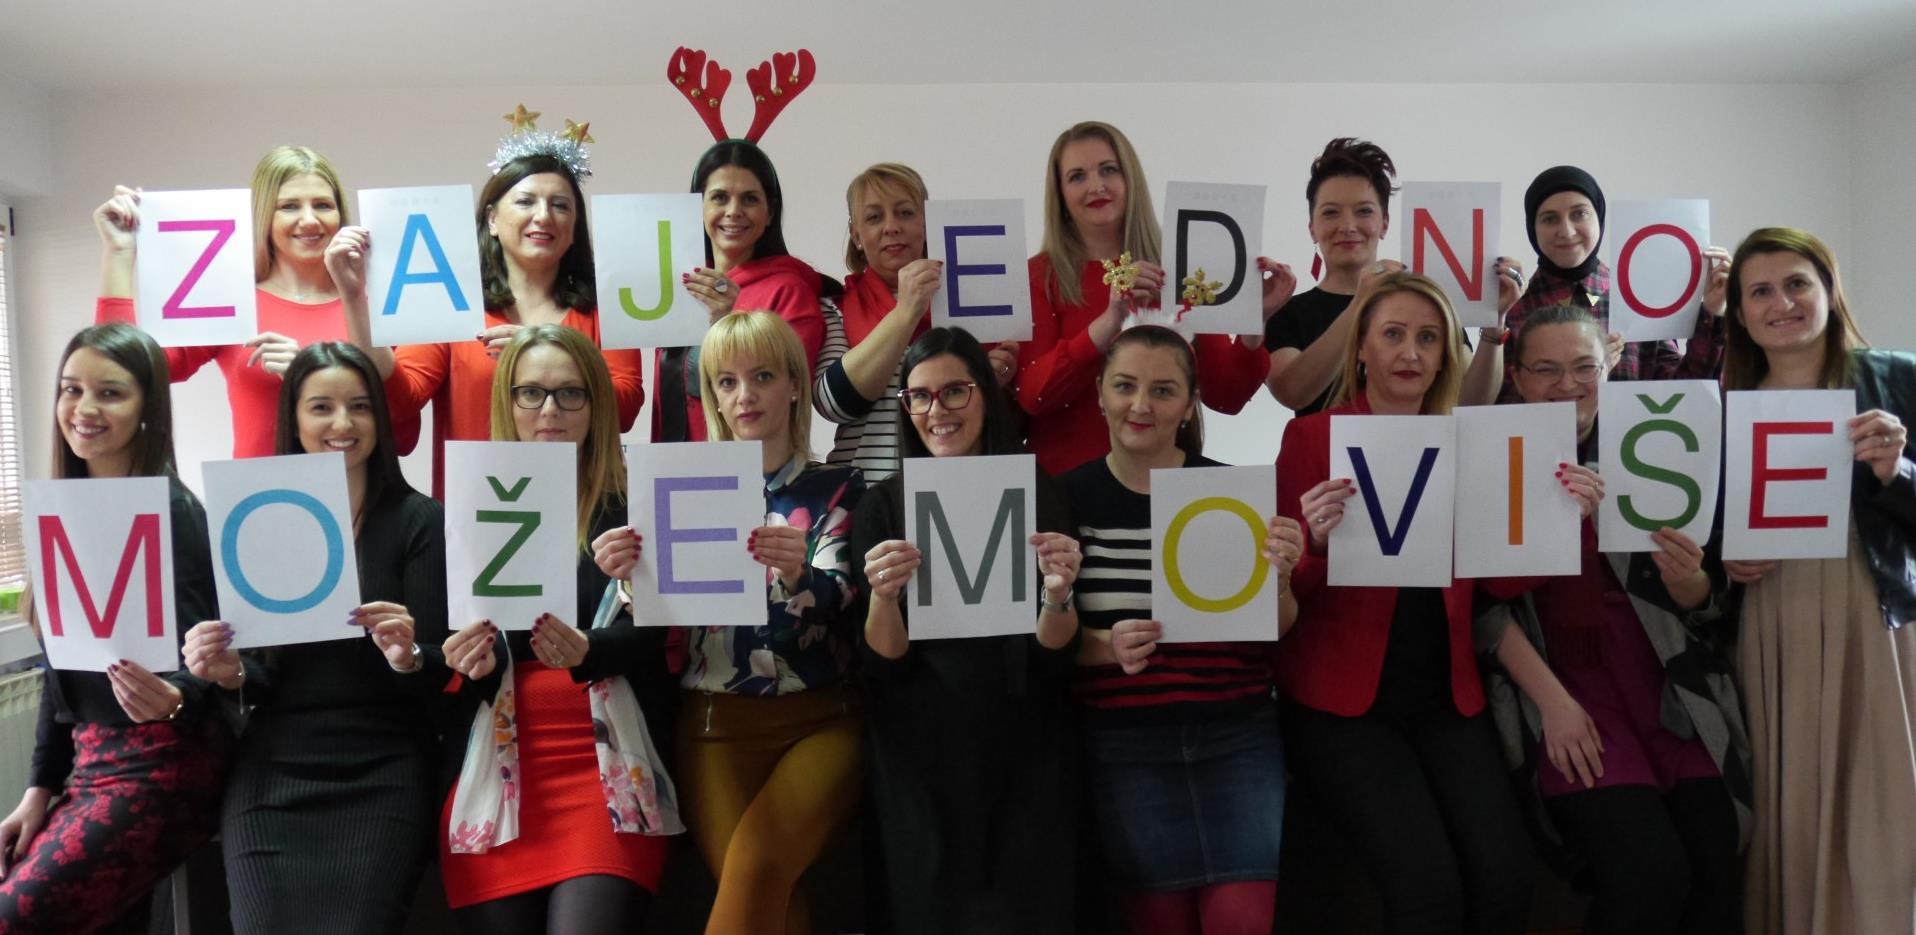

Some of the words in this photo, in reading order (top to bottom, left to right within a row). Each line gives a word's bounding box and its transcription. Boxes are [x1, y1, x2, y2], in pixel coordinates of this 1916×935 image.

[158, 219, 236, 319] Z
[382, 214, 470, 315] A
[618, 220, 673, 321] J
[944, 225, 1013, 317] E
[1176, 209, 1247, 306] D
[1413, 208, 1484, 301] N
[1617, 224, 1702, 318] O
[1347, 447, 1440, 556] V
[1508, 436, 1523, 545] I
[1617, 394, 1701, 531] Š
[1748, 422, 1834, 529] E
[38, 514, 164, 639] M
[221, 489, 344, 614] O
[473, 476, 543, 597] Ž
[655, 476, 745, 594] E
[915, 488, 1026, 607] M
[1162, 497, 1270, 613] O
